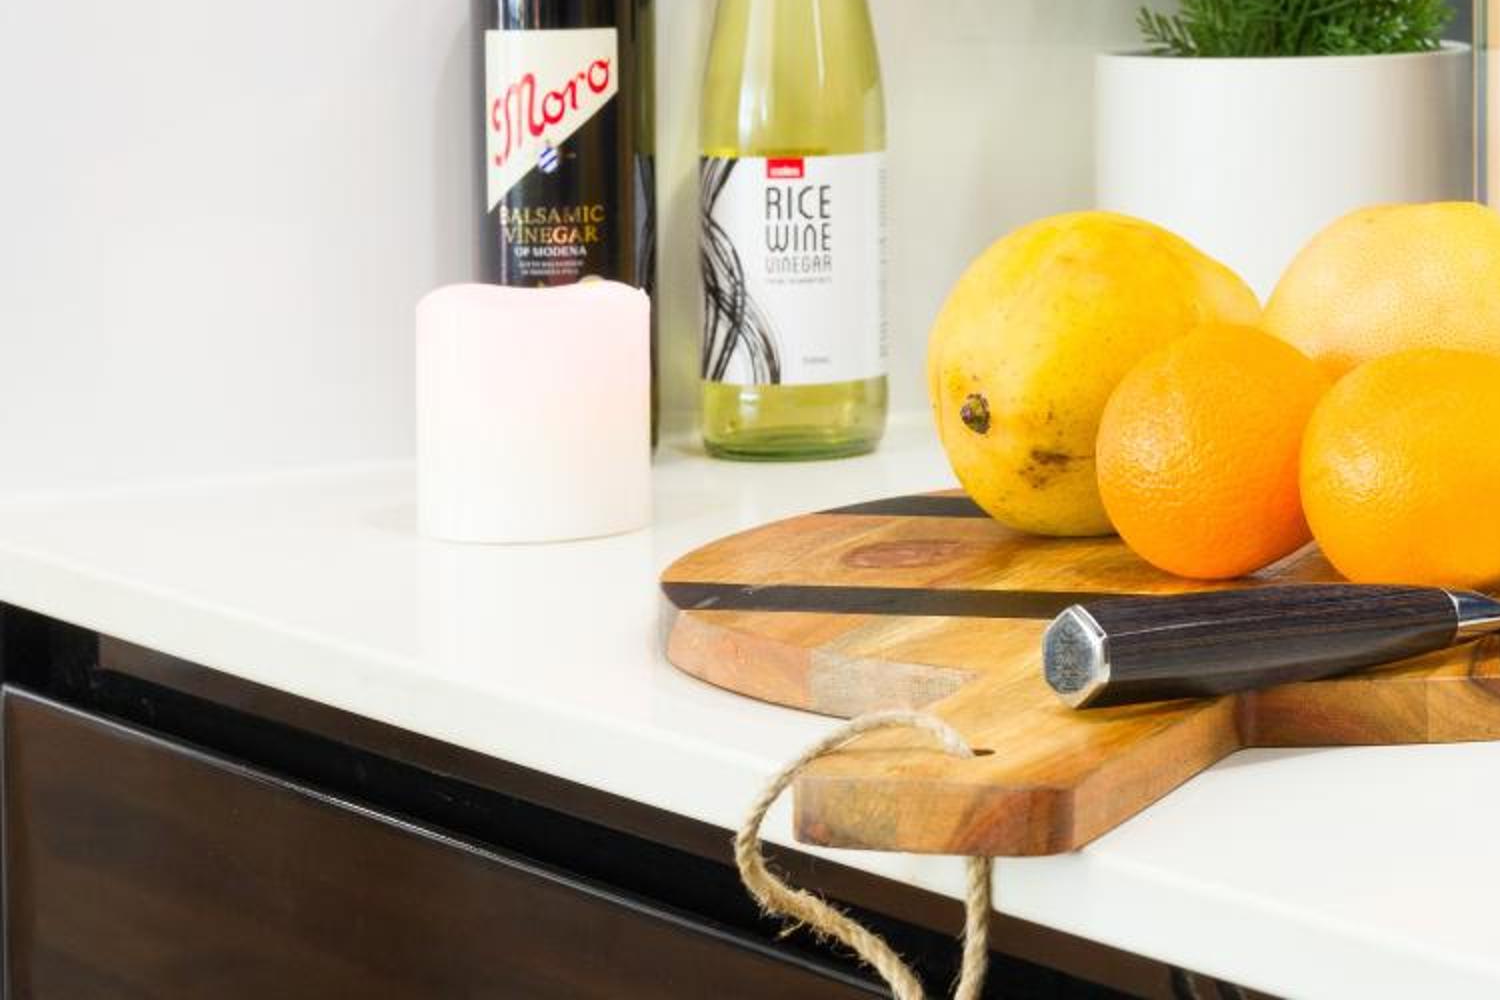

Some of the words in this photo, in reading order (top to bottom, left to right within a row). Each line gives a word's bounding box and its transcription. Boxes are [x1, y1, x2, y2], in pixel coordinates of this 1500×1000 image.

[491, 57, 609, 166] Moro
[766, 185, 832, 220] RICE
[499, 205, 605, 224] BALSAMIC
[501, 226, 598, 245] VINEGAR
[766, 223, 832, 252] WINE
[514, 246, 530, 257] OF
[533, 246, 587, 257] MODENA
[766, 254, 832, 274] VINEGAR
